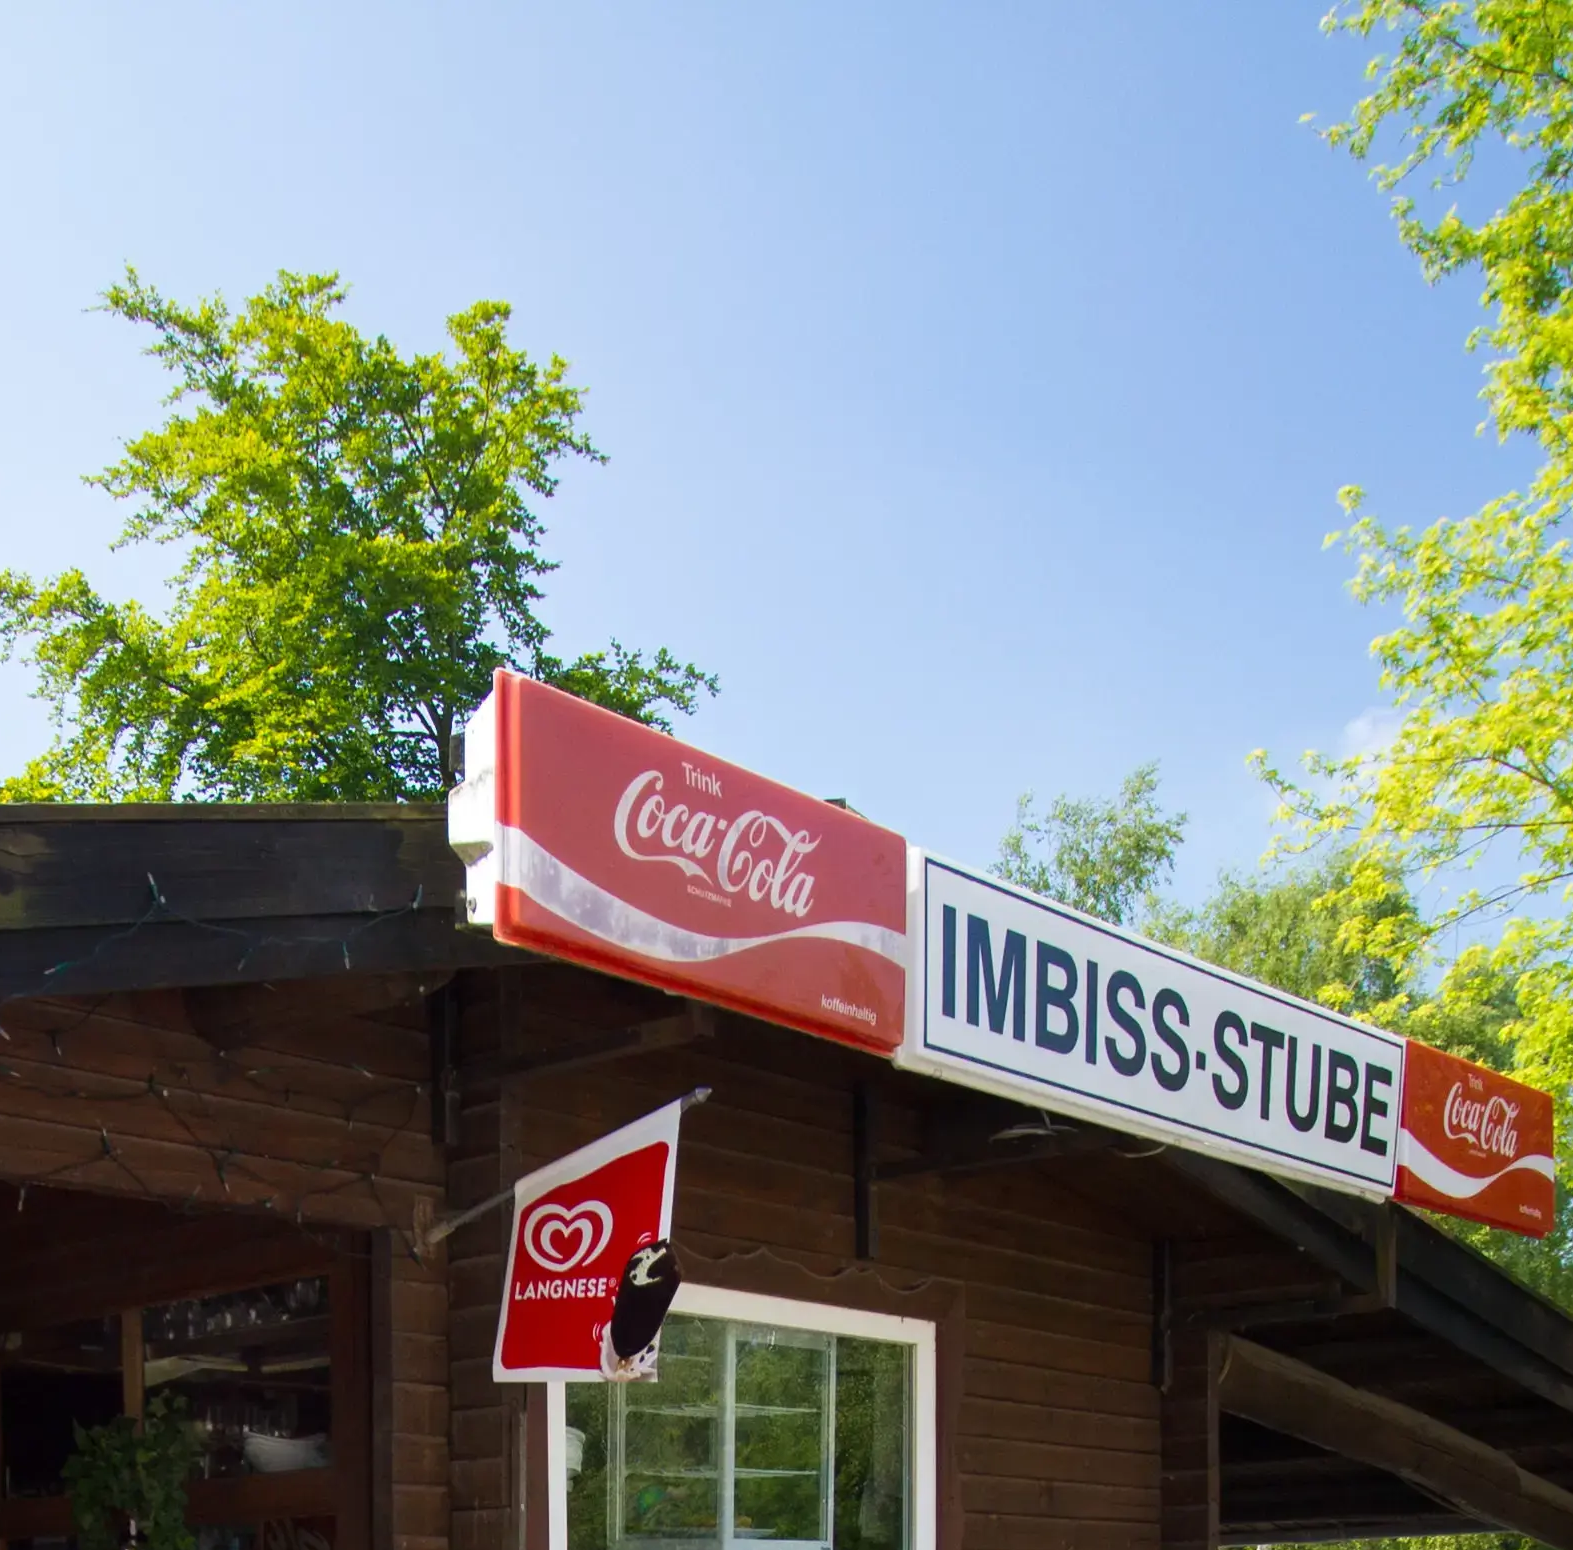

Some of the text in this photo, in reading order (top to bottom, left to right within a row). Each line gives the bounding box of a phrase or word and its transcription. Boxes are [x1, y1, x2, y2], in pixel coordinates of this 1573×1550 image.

[682, 762, 723, 798] Trink
[614, 770, 822, 918] Coca-Cola
[821, 994, 877, 1026] koffeinhaltig
[1443, 1081, 1521, 1158] Coca-Cola
[514, 1277, 608, 1301] LANGNESE
